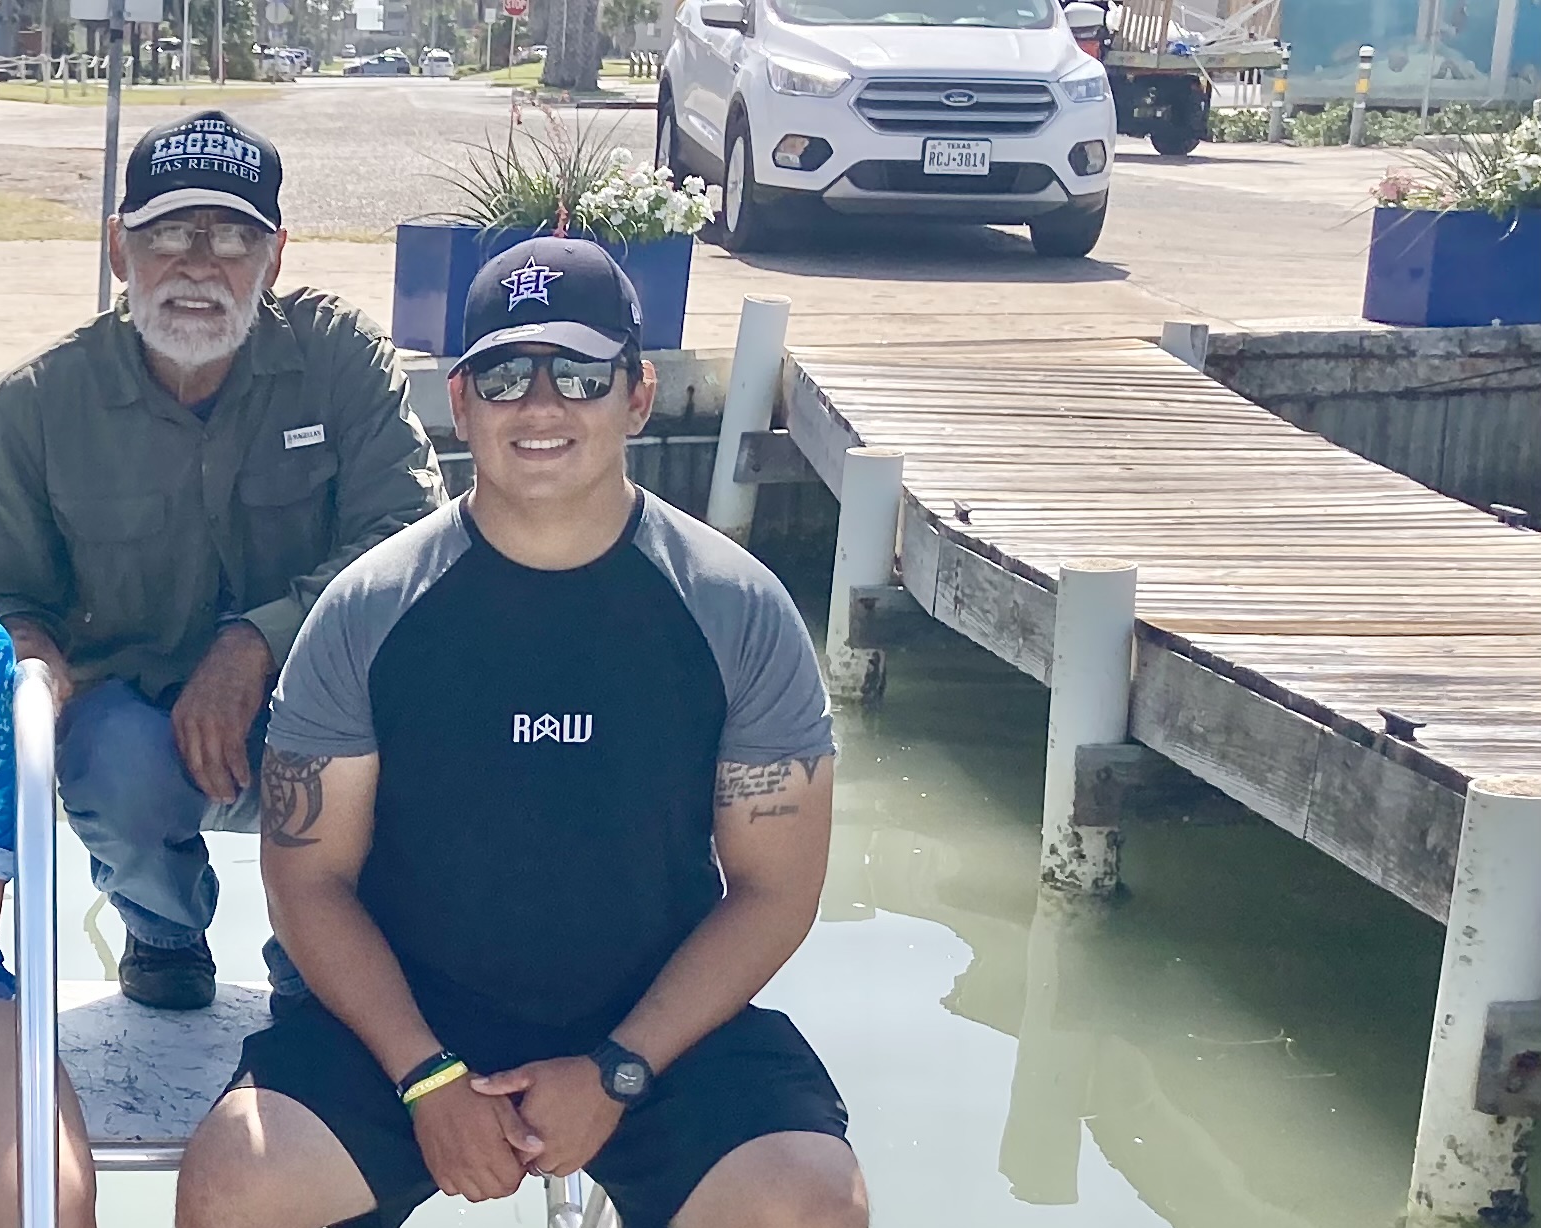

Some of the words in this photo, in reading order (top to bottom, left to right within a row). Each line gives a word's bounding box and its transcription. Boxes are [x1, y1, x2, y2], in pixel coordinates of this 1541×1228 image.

[194, 119, 226, 133] THE
[152, 132, 261, 167] LEGEND
[151, 158, 182, 176] HAS
[188, 158, 260, 183] RETIRED
[512, 712, 593, 743] RAW
